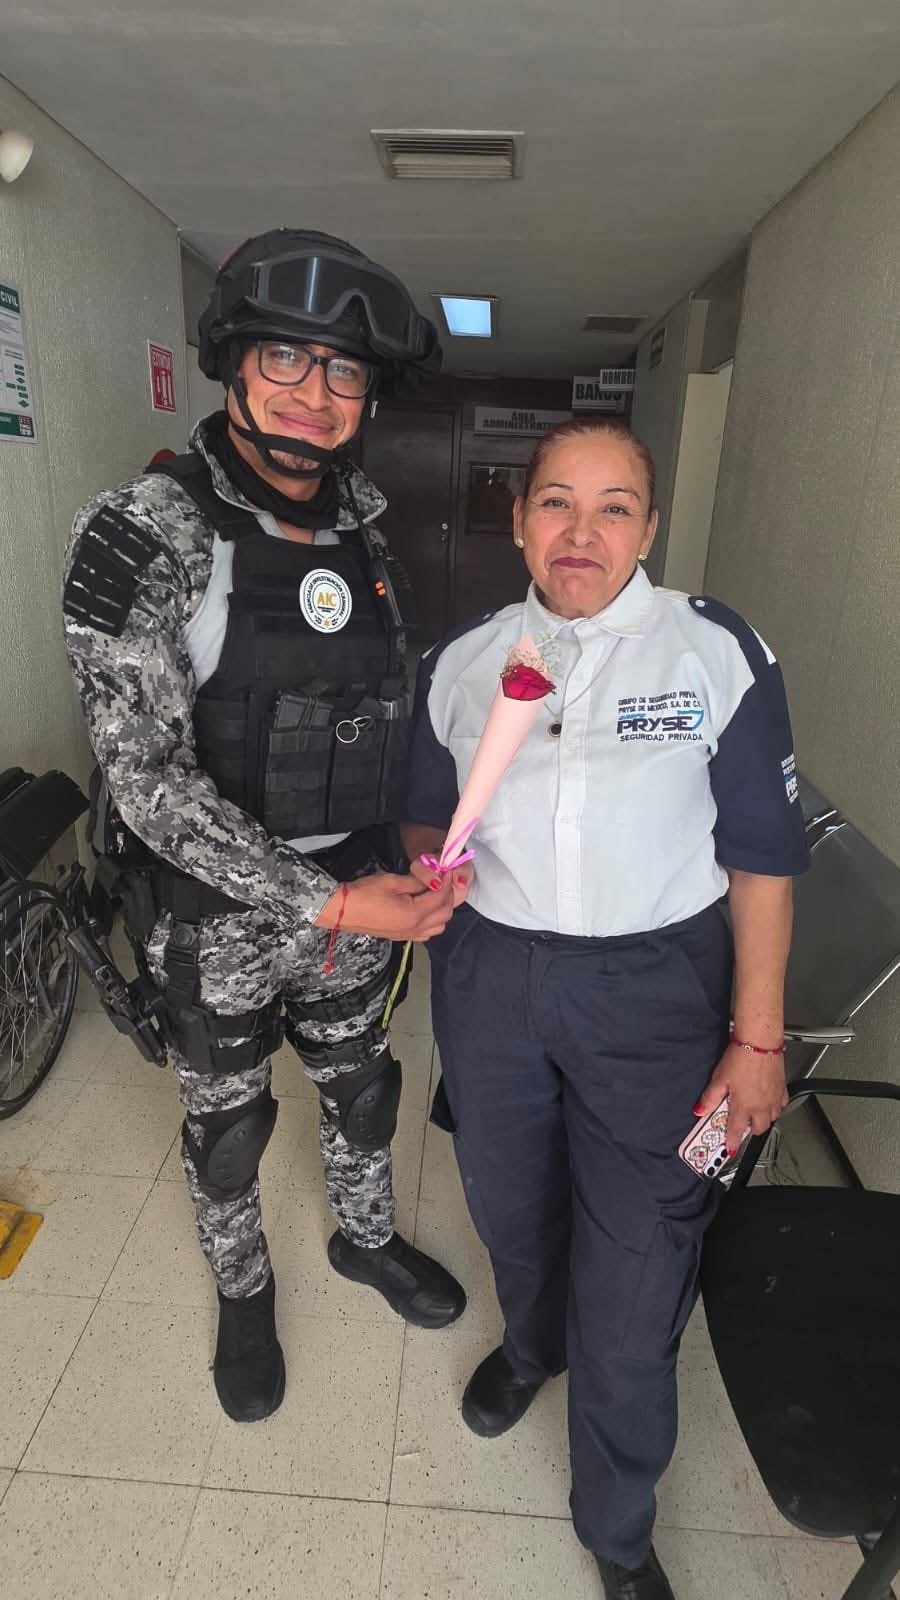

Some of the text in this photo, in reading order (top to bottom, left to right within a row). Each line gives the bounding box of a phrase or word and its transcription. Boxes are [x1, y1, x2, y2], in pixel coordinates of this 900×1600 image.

[317, 592, 337, 607] AIC
[648, 691, 677, 703] SEGURIDAD
[683, 700, 691, 708] DE
[617, 716, 693, 734] PRYSE
[620, 733, 704, 742] SEGURIDAD PRIVADA
